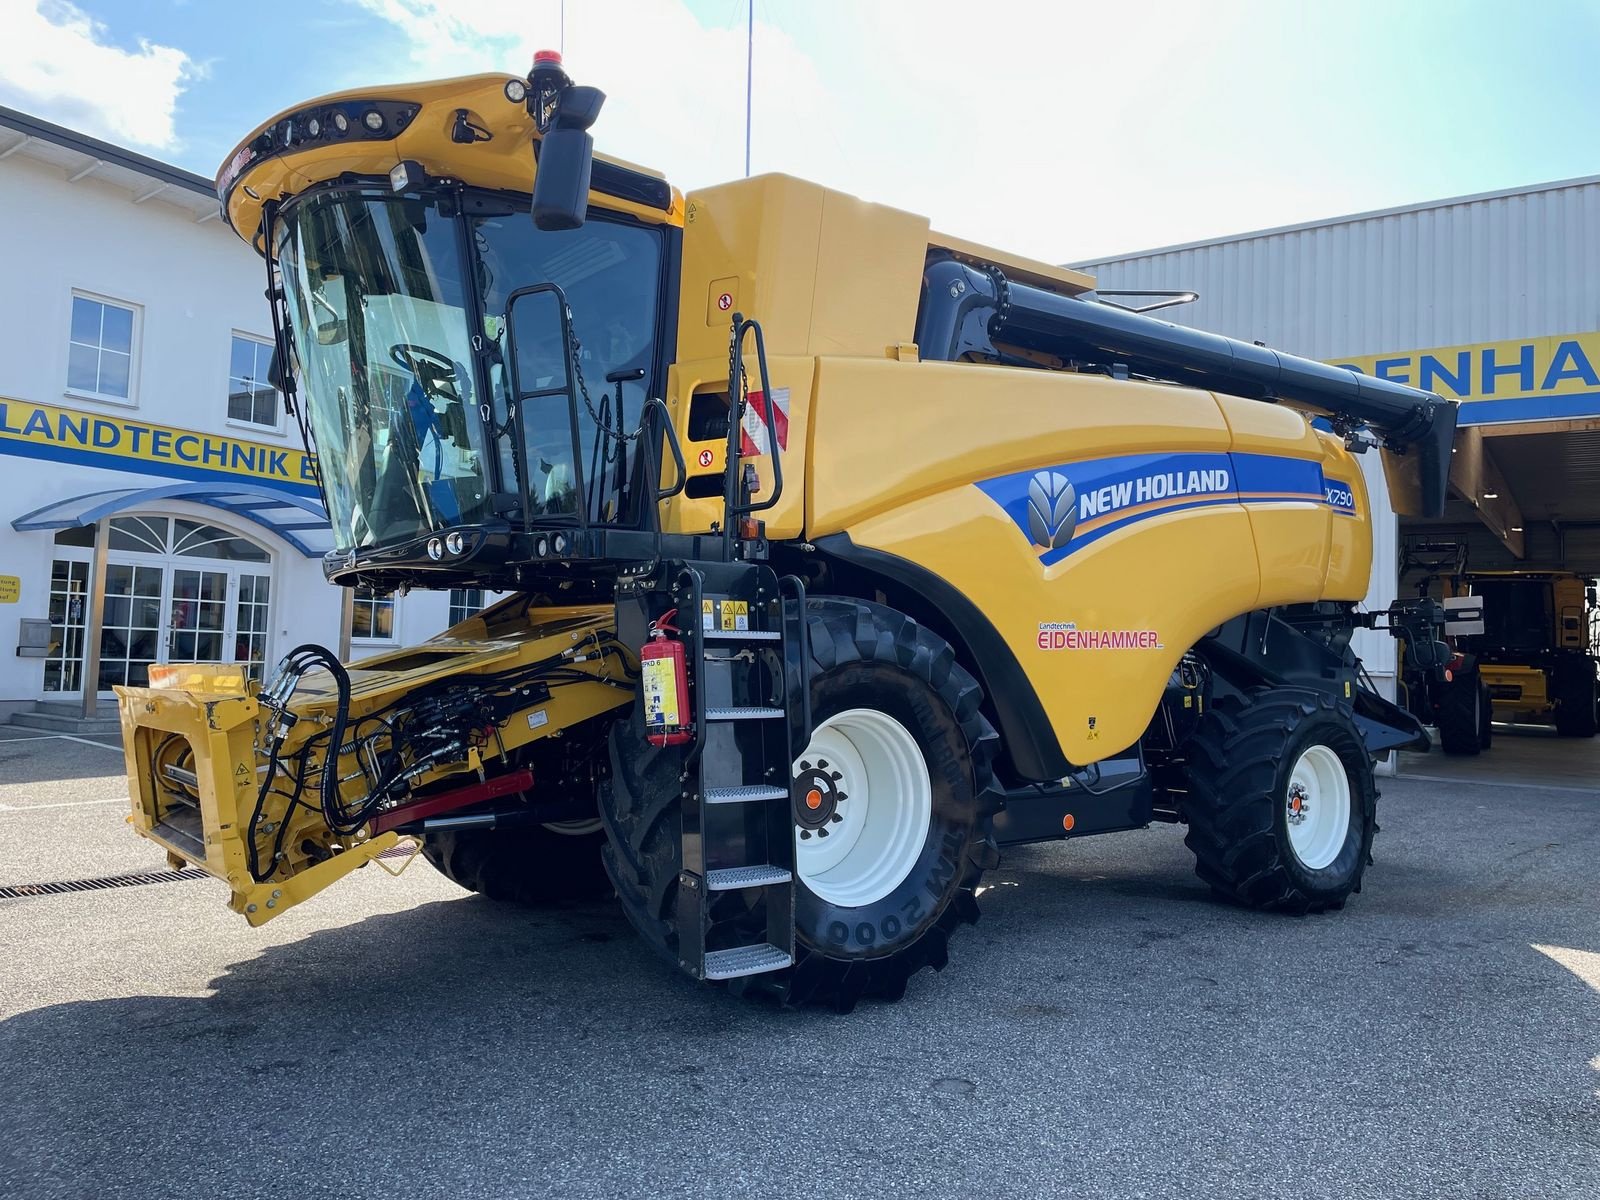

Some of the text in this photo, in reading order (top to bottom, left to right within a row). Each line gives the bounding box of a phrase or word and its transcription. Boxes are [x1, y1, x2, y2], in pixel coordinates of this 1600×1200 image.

[0, 404, 289, 477] LANDTECHNIK
[1080, 470, 1229, 520] NEW HOLLAND
[1038, 631, 1158, 649] EIDENHAMMER
[828, 895, 926, 946] 2000
